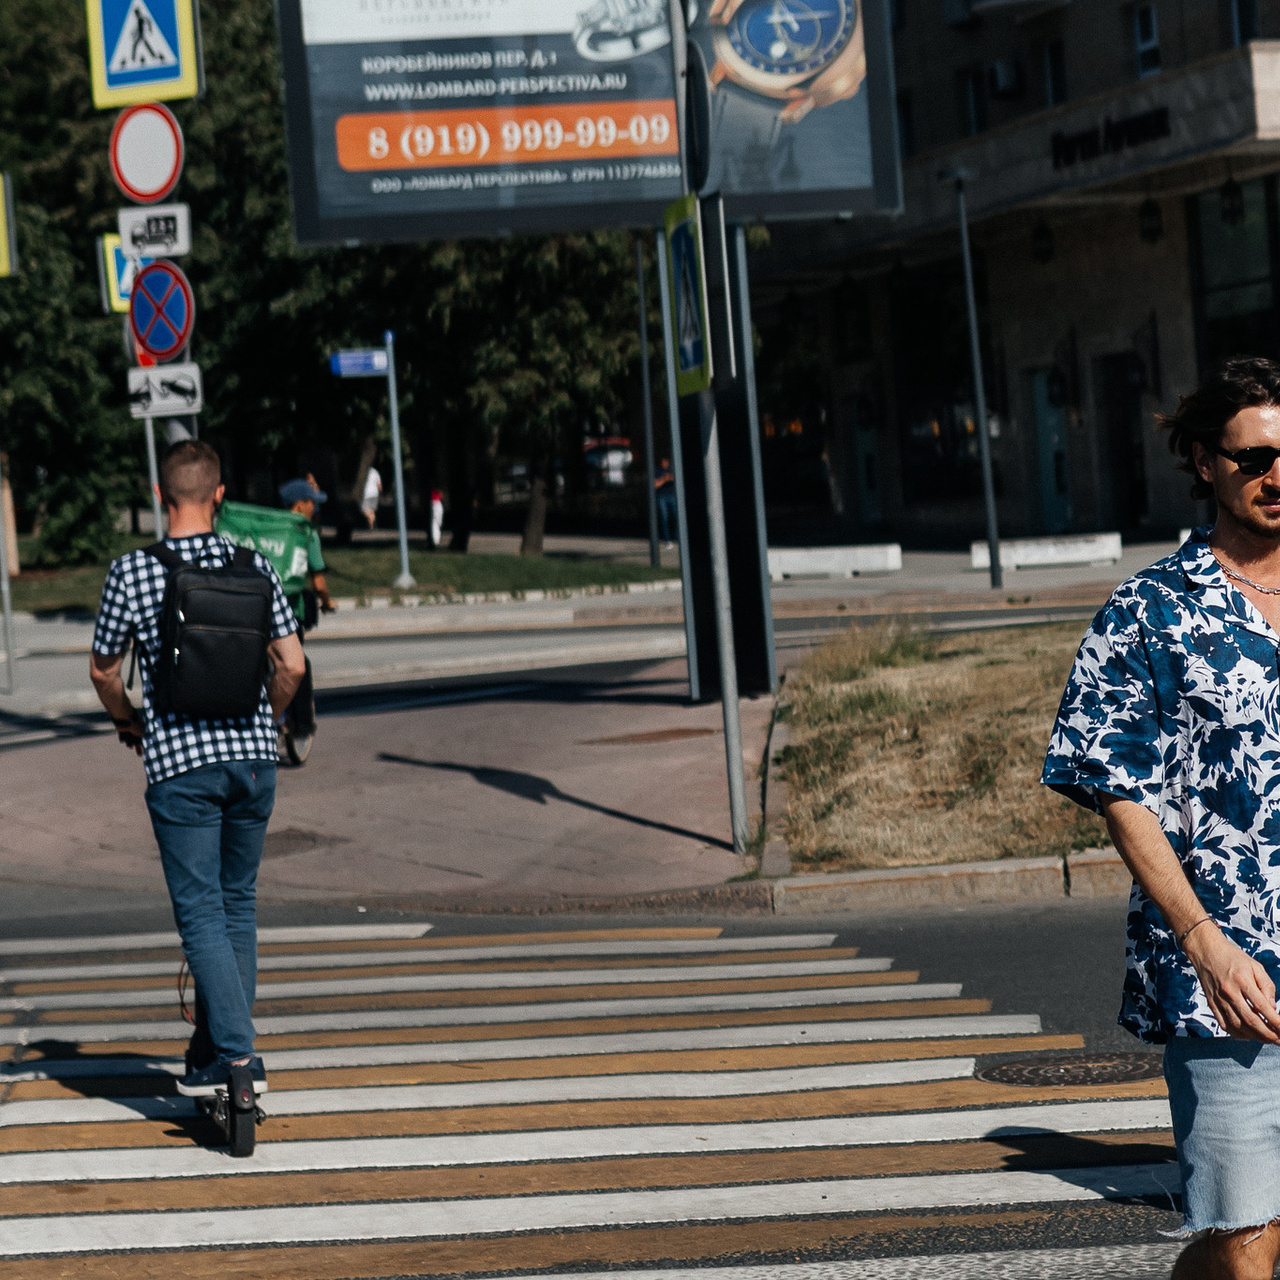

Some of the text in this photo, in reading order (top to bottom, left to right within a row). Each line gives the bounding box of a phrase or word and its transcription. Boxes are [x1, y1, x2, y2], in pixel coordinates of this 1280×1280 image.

[362, 51, 493, 74] КОРОБЕЙНИКОВ
[368, 113, 671, 161] 8 (919) 999-99-09
[371, 177, 402, 194] ООО
[572, 167, 605, 183] ОГРН
